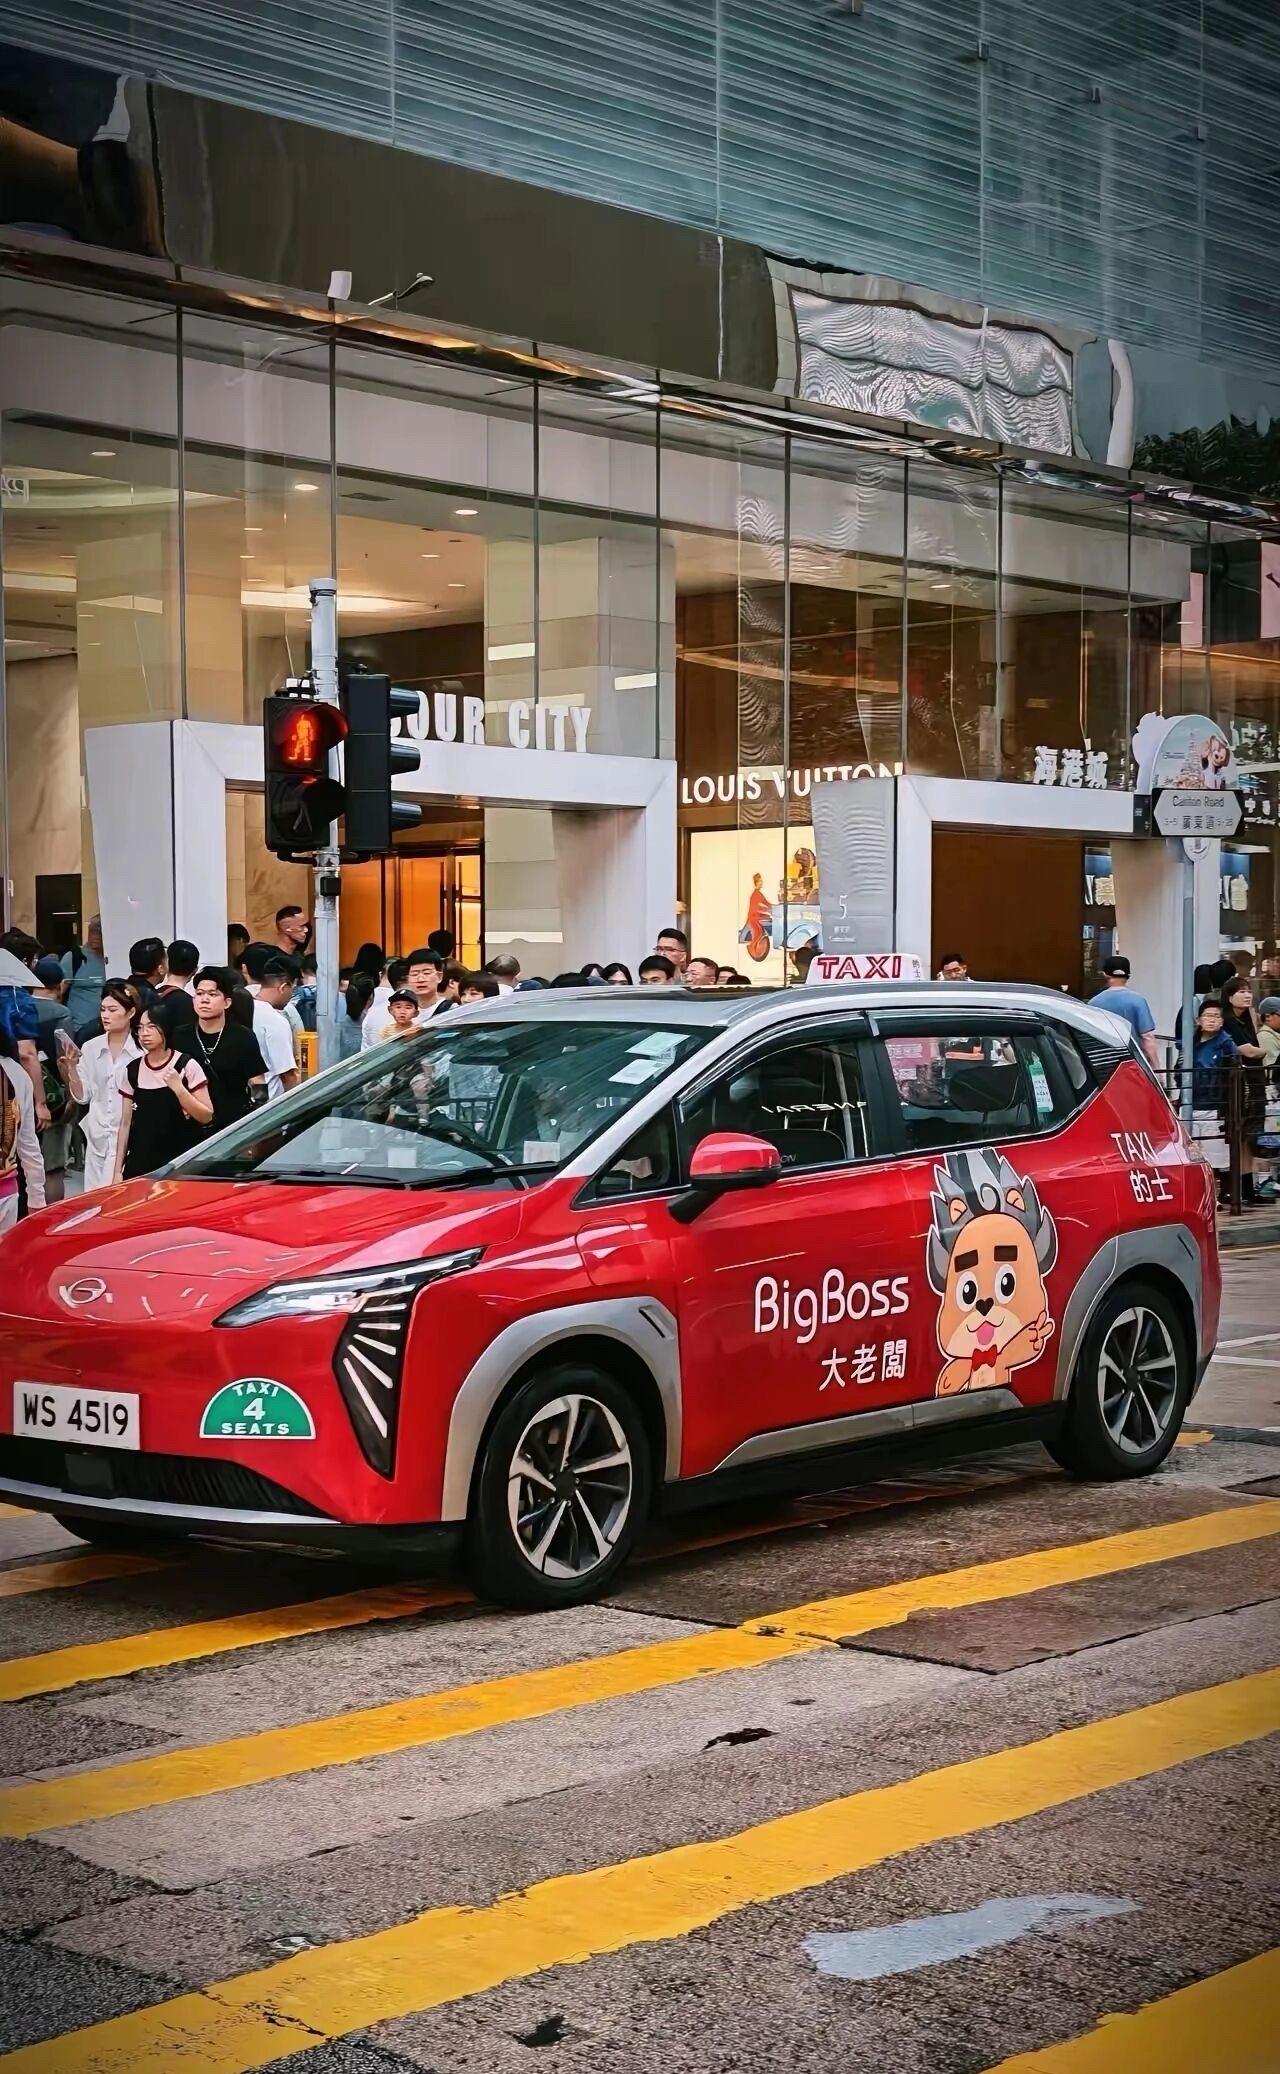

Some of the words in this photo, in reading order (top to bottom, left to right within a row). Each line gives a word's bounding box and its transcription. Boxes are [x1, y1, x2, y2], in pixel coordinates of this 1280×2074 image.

[508, 700, 592, 753] CITY
[1033, 745, 1109, 789] 海港城
[682, 772, 762, 804] LOUIS
[1204, 796, 1224, 807] Road
[839, 894, 848, 919] 5
[817, 956, 902, 979] TAXI
[1110, 1132, 1158, 1162] TAXI
[1130, 1168, 1173, 1202] 的士
[754, 1268, 909, 1344] BigBoss
[819, 1339, 907, 1391] 大老闆
[233, 1381, 280, 1397] TAXI
[23, 1393, 56, 1427] WS
[67, 1399, 129, 1436] 4519
[243, 1398, 266, 1420] 4
[221, 1422, 290, 1435] SEATS
